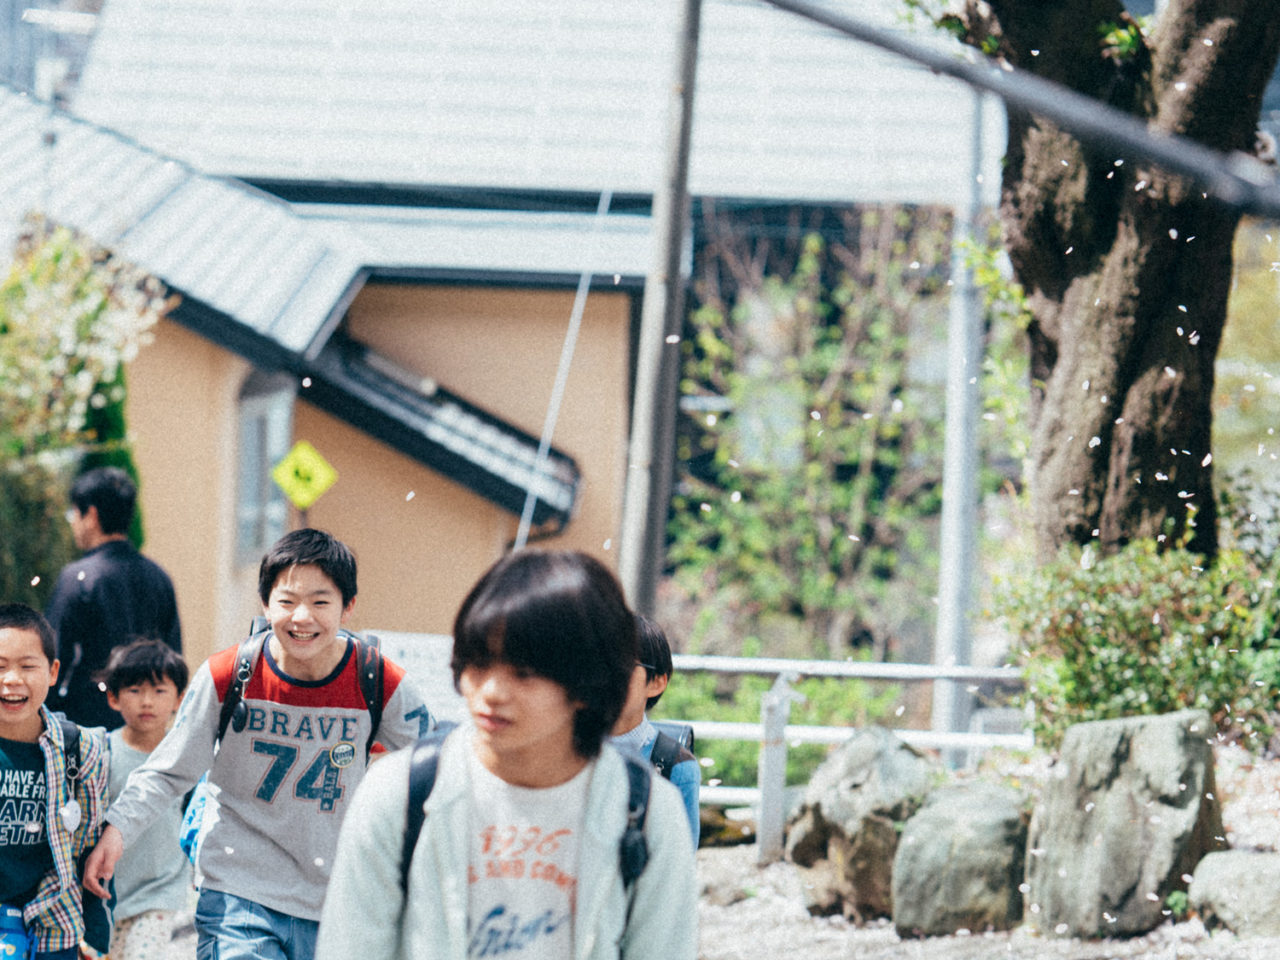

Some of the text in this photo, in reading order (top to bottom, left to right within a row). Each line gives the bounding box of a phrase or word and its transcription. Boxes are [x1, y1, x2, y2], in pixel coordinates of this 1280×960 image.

[247, 707, 358, 742] BRAVE
[5, 769, 35, 785] HAVE
[36, 771, 44, 784] A
[251, 738, 345, 813] 74
[32, 784, 47, 799] FR
